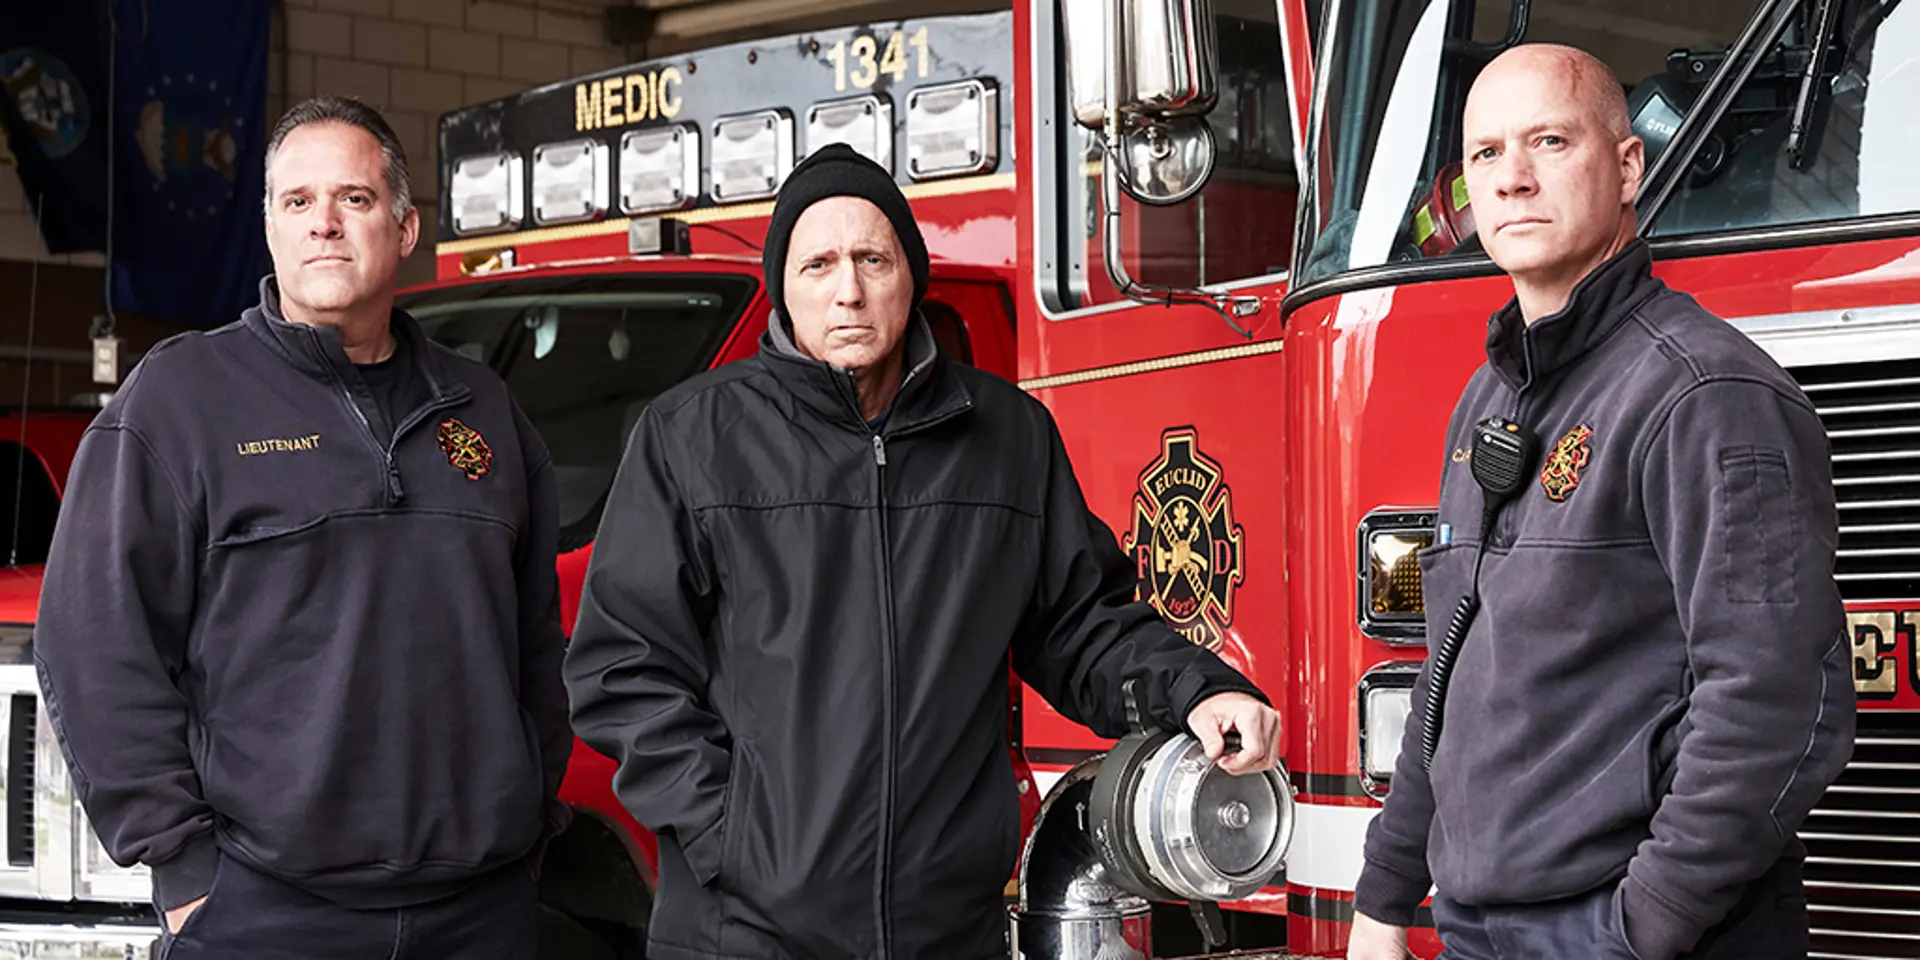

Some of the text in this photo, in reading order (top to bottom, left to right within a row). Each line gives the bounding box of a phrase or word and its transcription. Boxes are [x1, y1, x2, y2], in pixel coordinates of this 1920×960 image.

[827, 26, 931, 91] 1341
[575, 66, 683, 132] MEDIC
[237, 434, 320, 455] LIEUTENANT
[1155, 467, 1207, 496] EUCLID
[1136, 544, 1151, 579] F
[1214, 539, 1232, 575] D
